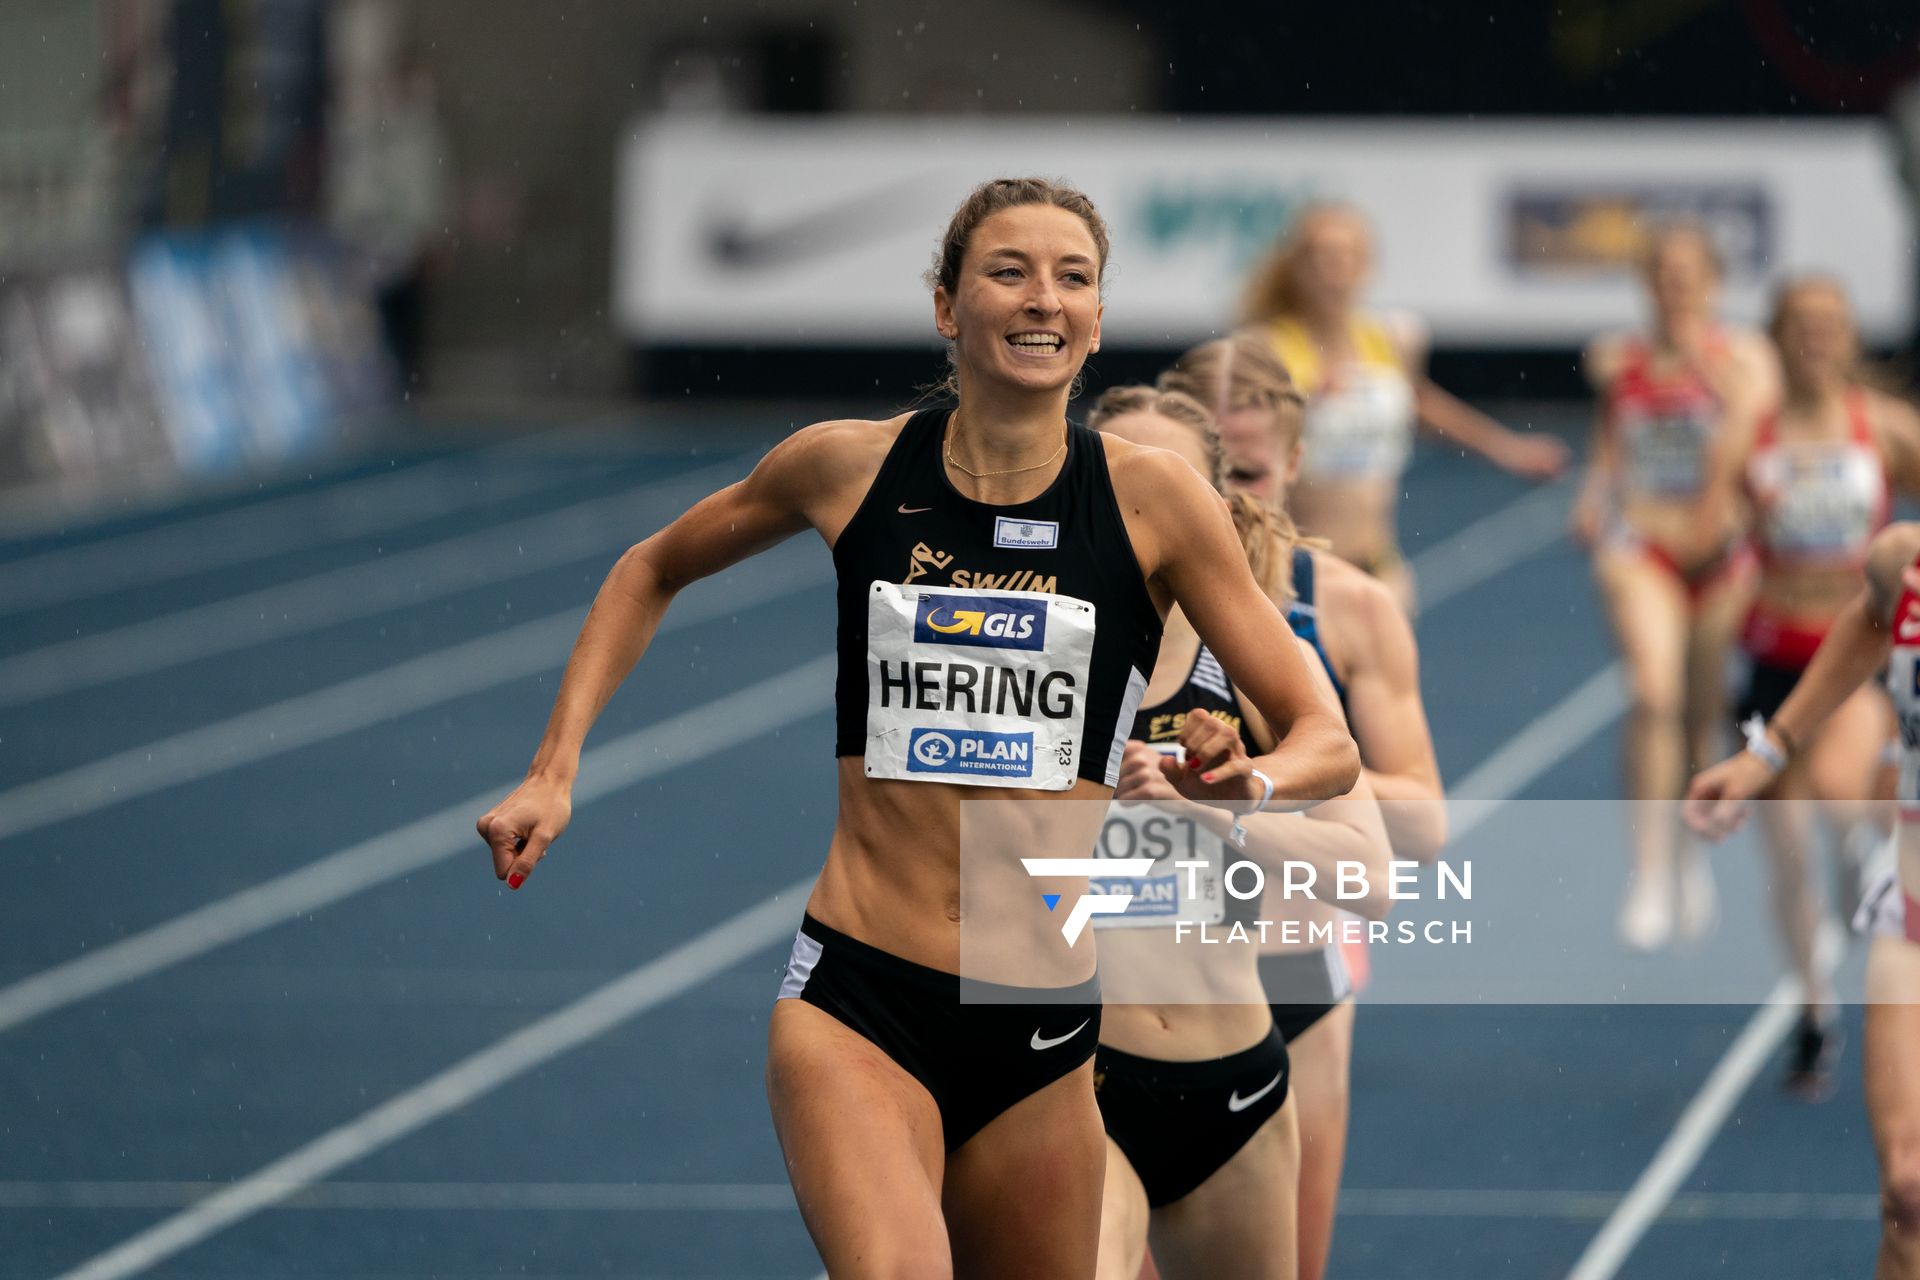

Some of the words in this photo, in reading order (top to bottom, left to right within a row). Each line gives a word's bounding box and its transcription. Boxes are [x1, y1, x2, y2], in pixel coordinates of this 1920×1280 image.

[1001, 537, 1050, 546] Bundeswehr
[984, 613, 1035, 639] GLS
[880, 660, 1075, 719] HERING
[960, 738, 1028, 761] PLAN
[1059, 739, 1073, 766] 123
[960, 760, 1028, 772] INTERNATIONAL
[1092, 816, 1198, 862] OST
